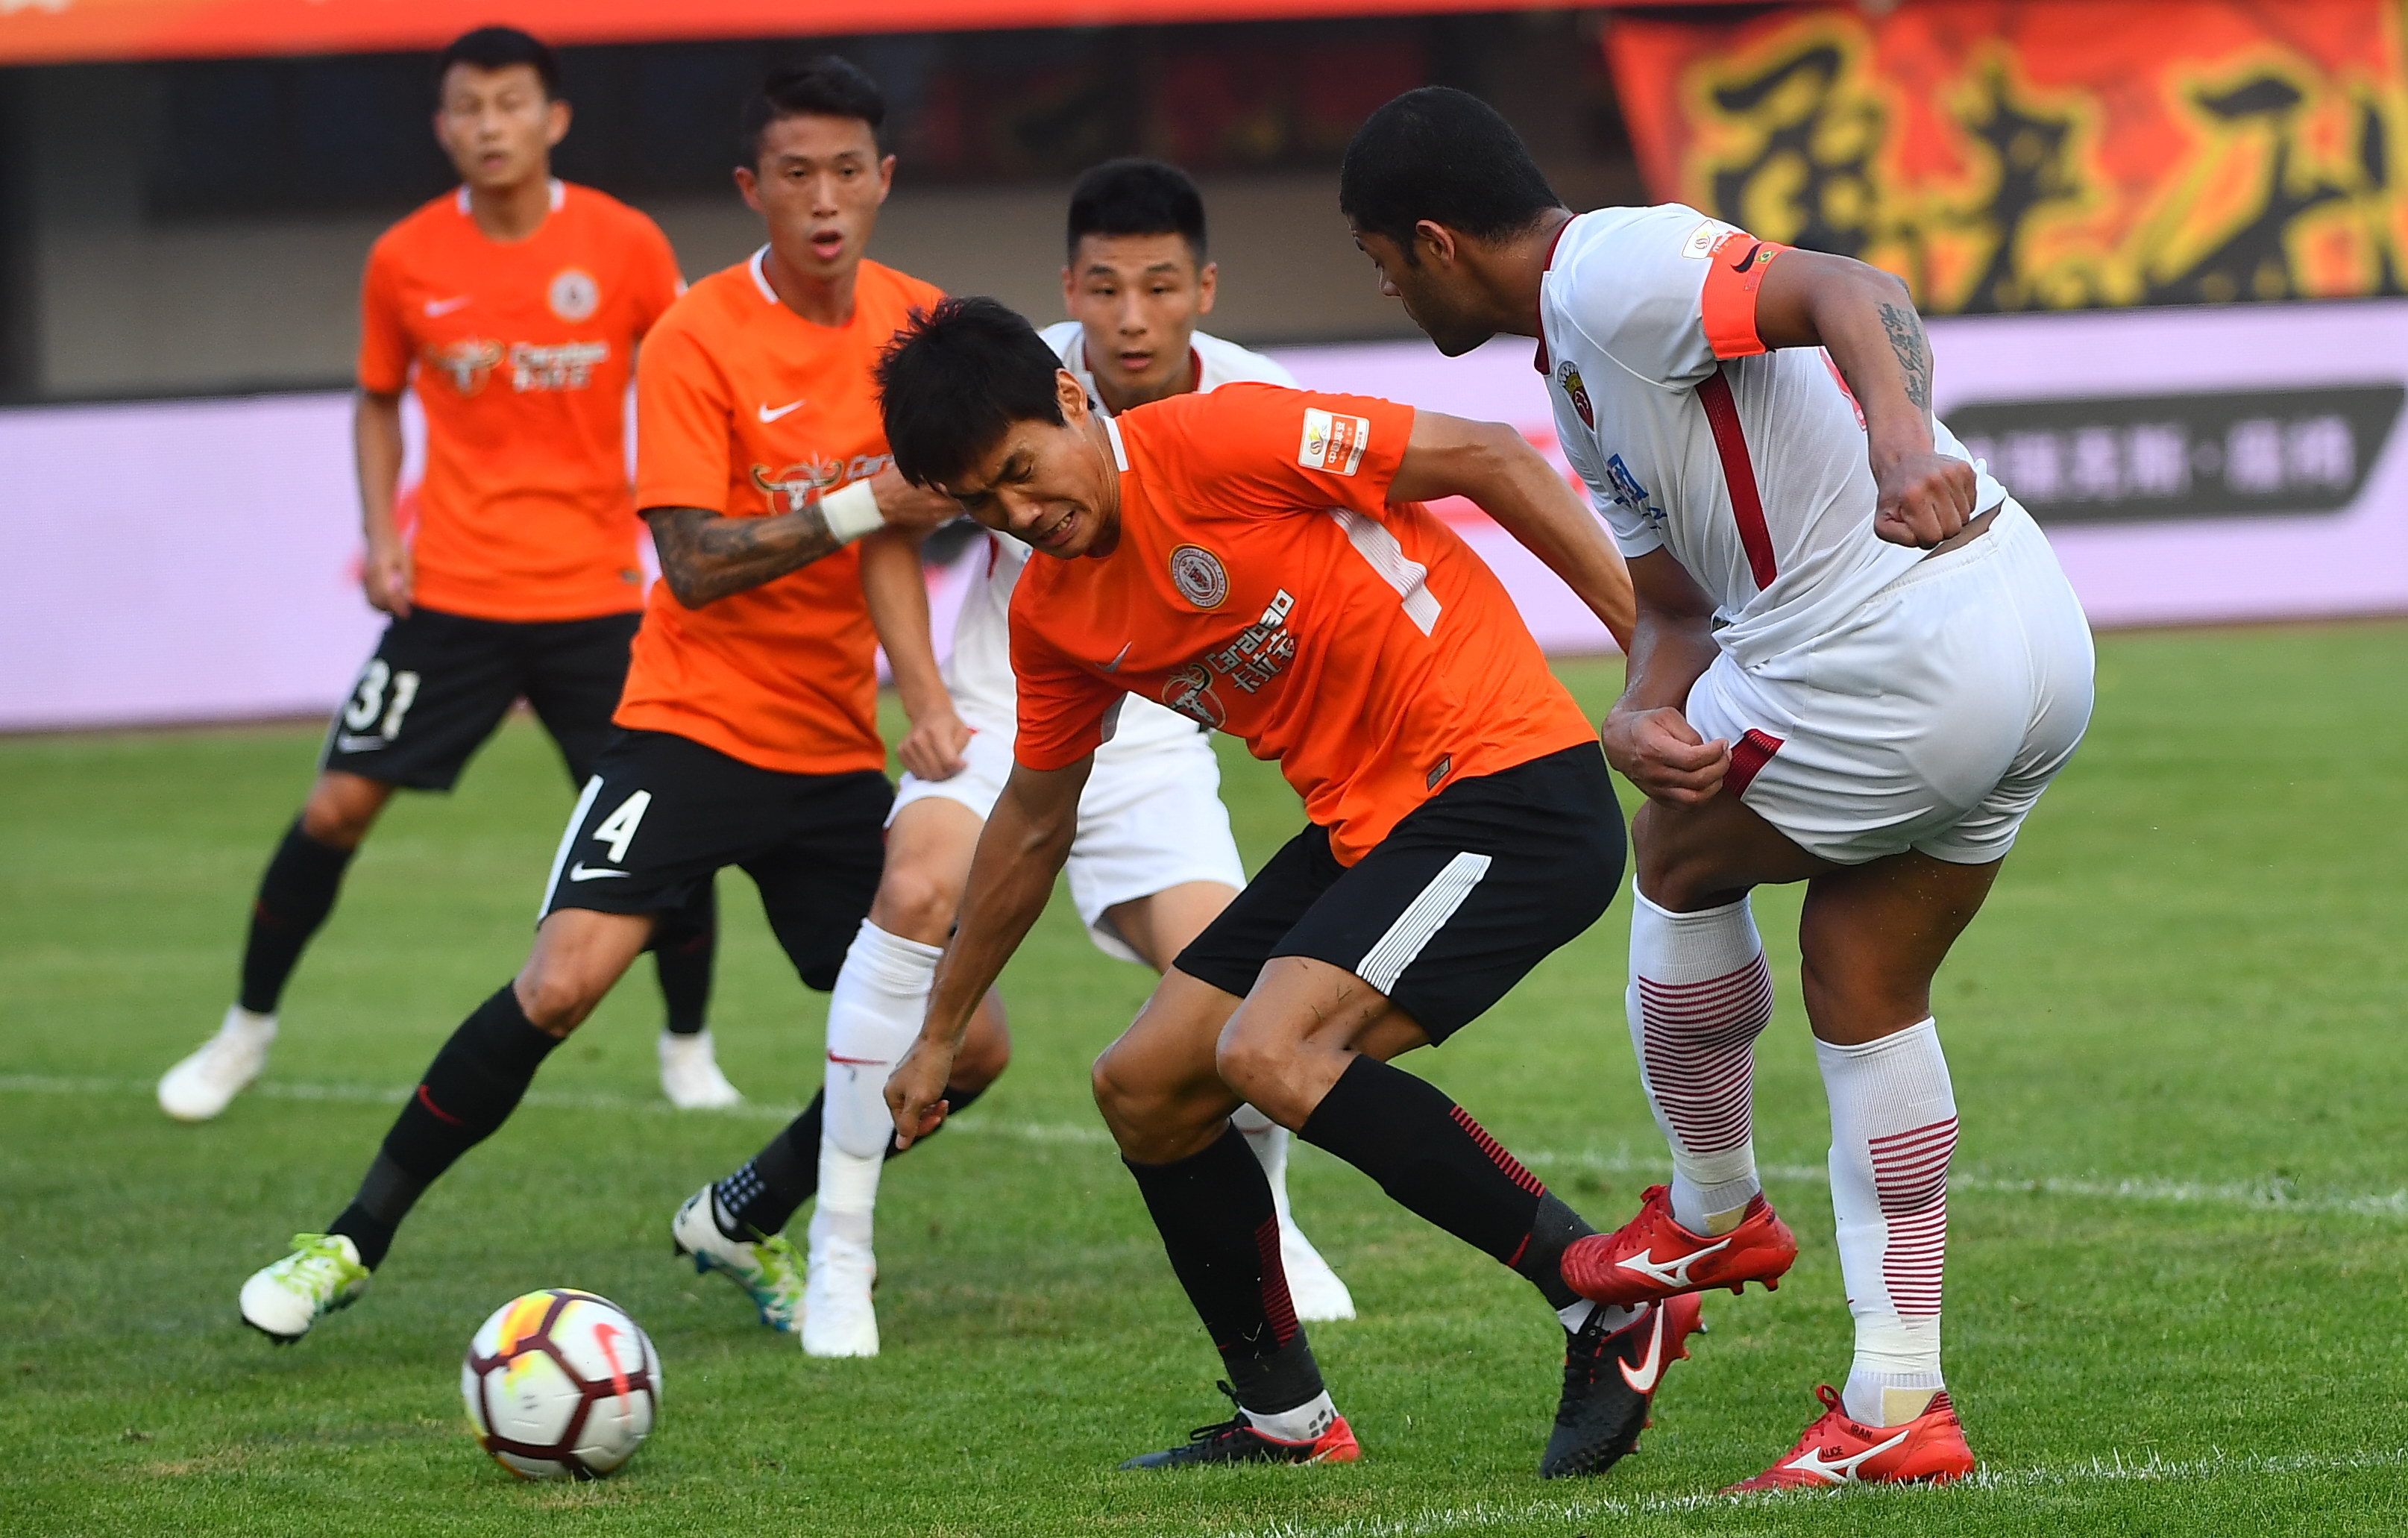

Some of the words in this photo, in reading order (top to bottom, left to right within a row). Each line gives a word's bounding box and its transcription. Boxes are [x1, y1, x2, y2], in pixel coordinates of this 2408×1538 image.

[342, 658, 421, 741] 31
[592, 788, 653, 864] 4
[1821, 1445, 1843, 1460] ALICE
[1850, 1423, 1873, 1440] IRAN
